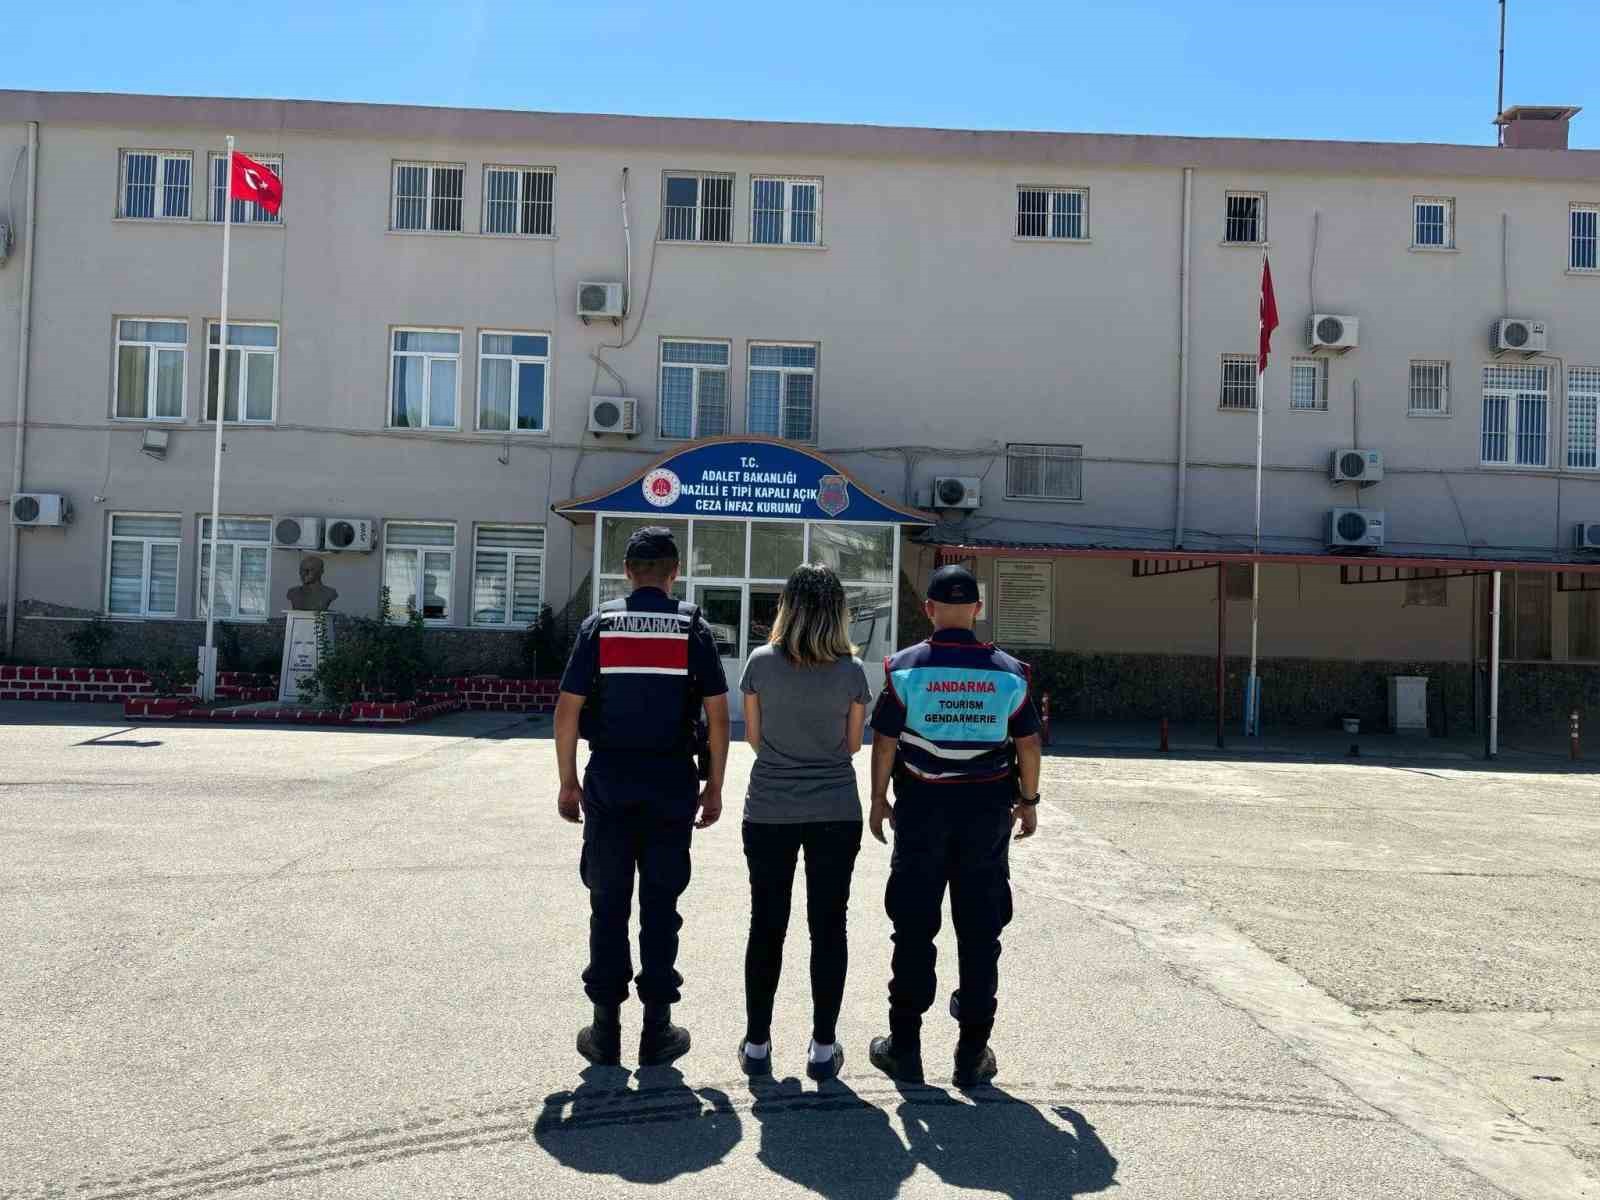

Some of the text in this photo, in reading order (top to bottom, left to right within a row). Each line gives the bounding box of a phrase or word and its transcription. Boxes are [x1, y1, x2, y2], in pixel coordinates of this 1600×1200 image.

[740, 457, 759, 468] T.C.
[702, 470, 797, 484] ADALET BAKANLIĞI
[681, 482, 817, 502] NAZİLLİ E TİPİ KAPALI AÇIK
[695, 498, 802, 514] CEZA İNFAZ KURUMU
[609, 615, 680, 633] JANDARMA
[926, 681, 995, 693] JANDARMA
[939, 700, 983, 710] TOURISM
[924, 713, 996, 723] GENDARMERIE
